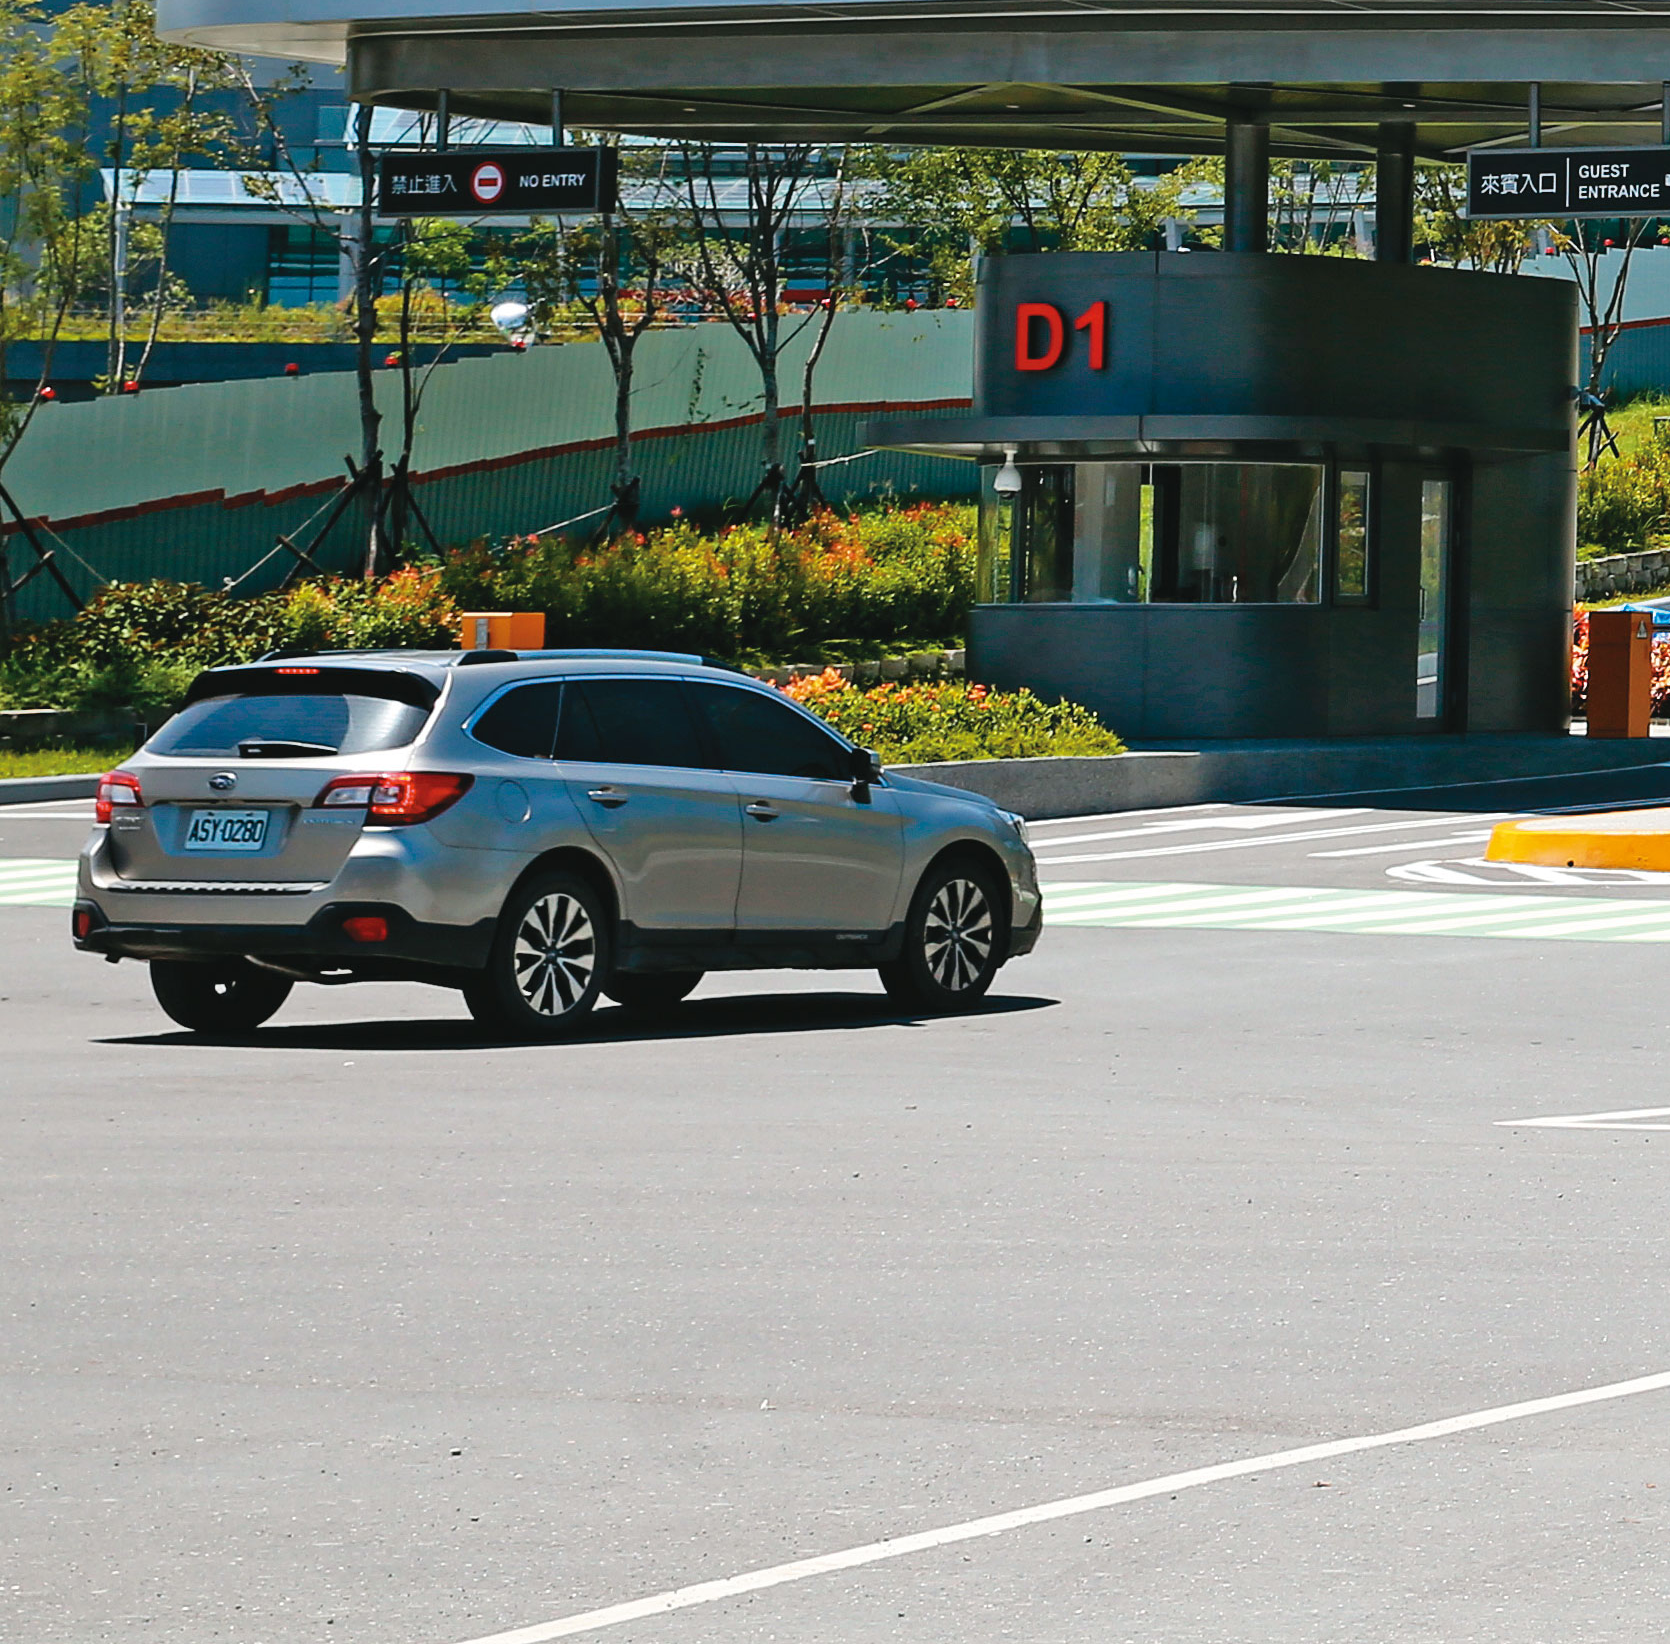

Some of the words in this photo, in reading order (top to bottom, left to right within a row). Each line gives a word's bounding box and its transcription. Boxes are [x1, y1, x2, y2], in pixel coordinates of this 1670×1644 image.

[519, 174, 540, 188] NO
[542, 173, 586, 188] ENTRY
[1578, 164, 1630, 179] GUEST
[391, 174, 457, 195] 禁止進入
[1481, 173, 1557, 195] 來賓入口
[1578, 184, 1660, 199] ENTRANCE
[1015, 301, 1106, 371] D1
[188, 819, 265, 844] ASY-0280
